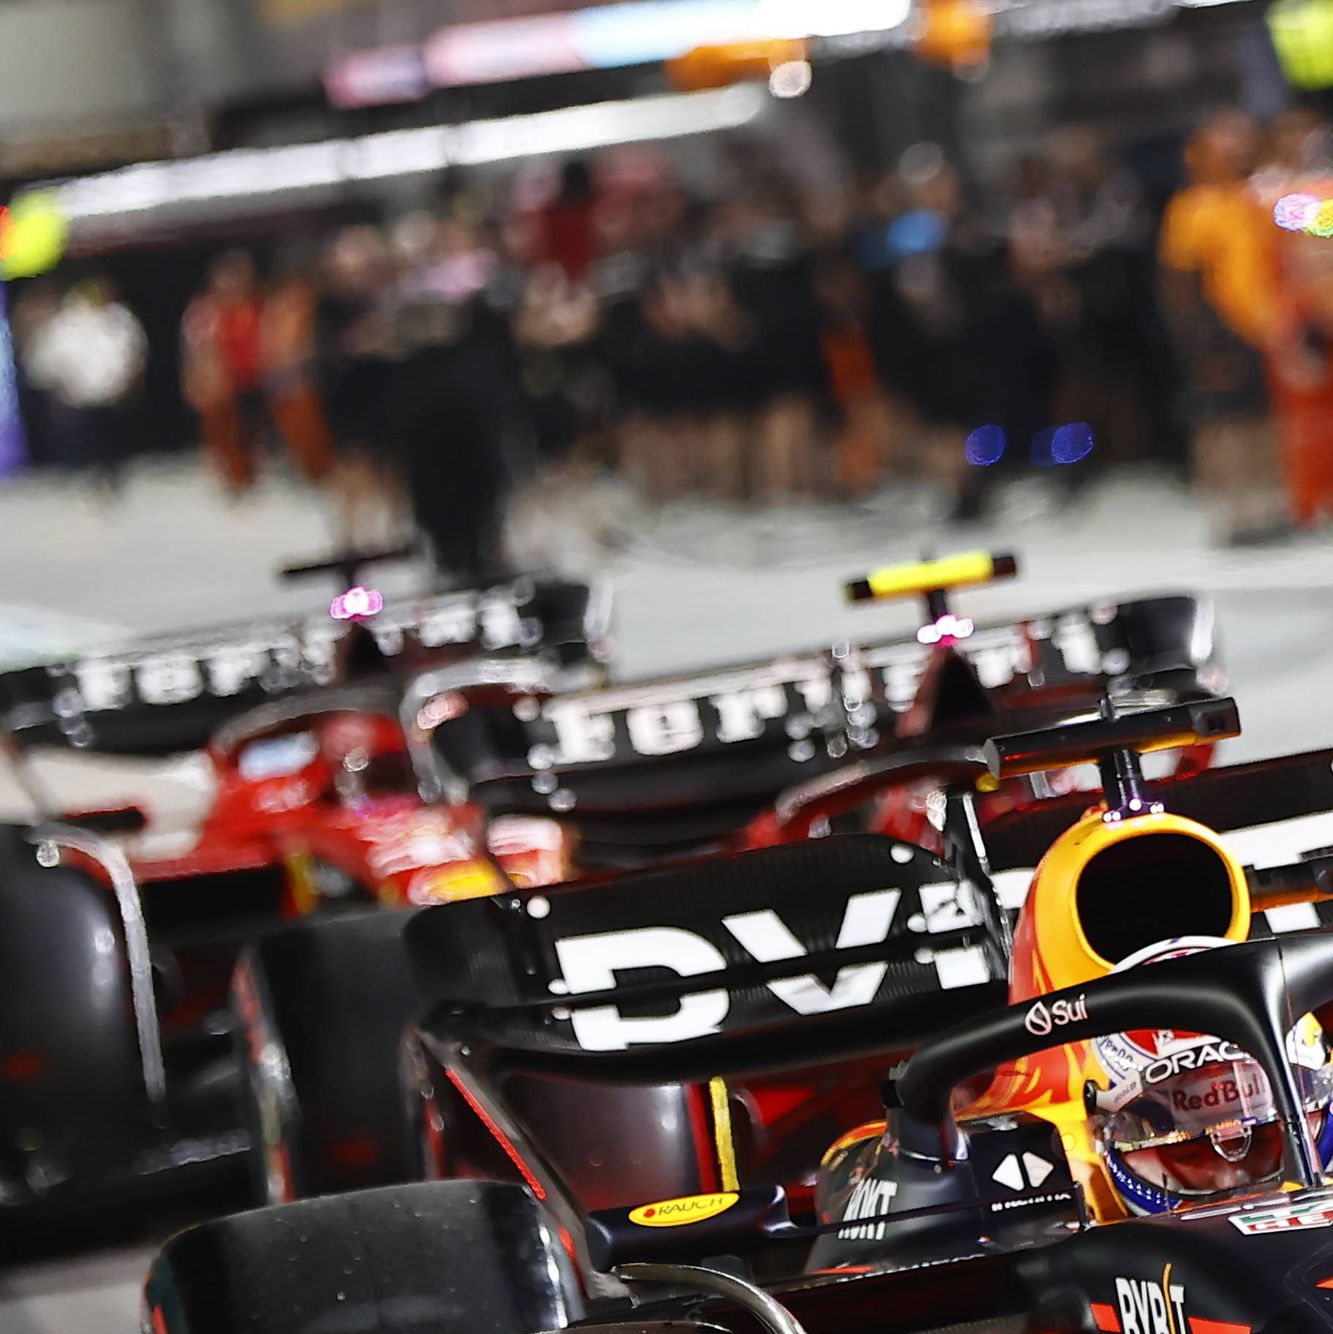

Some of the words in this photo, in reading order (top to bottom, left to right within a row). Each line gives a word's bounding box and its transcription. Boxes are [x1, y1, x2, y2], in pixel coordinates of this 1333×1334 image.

[1052, 994, 1088, 1025] Sui
[1145, 1041, 1250, 1083] ORAC
[658, 1196, 724, 1216] RAUCH
